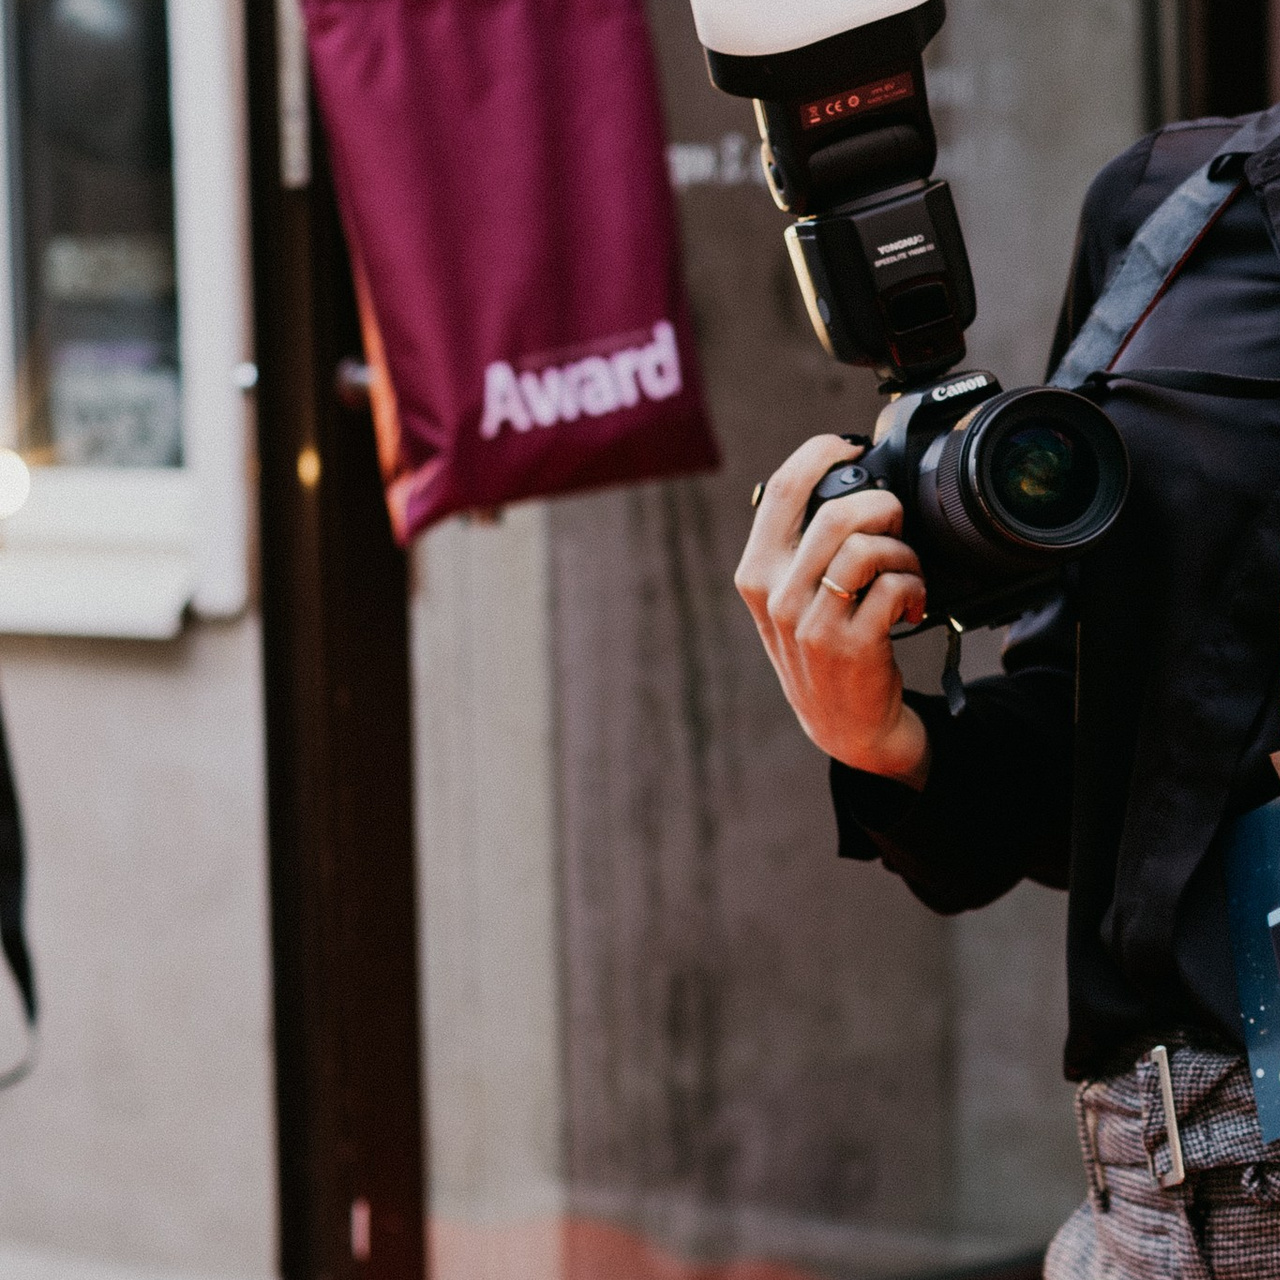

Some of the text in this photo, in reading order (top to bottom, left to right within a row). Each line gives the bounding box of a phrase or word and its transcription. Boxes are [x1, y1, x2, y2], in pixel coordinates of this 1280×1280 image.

[877, 234, 925, 255] YONGNUO
[479, 320, 683, 440] Award
[932, 374, 988, 401] Canon
